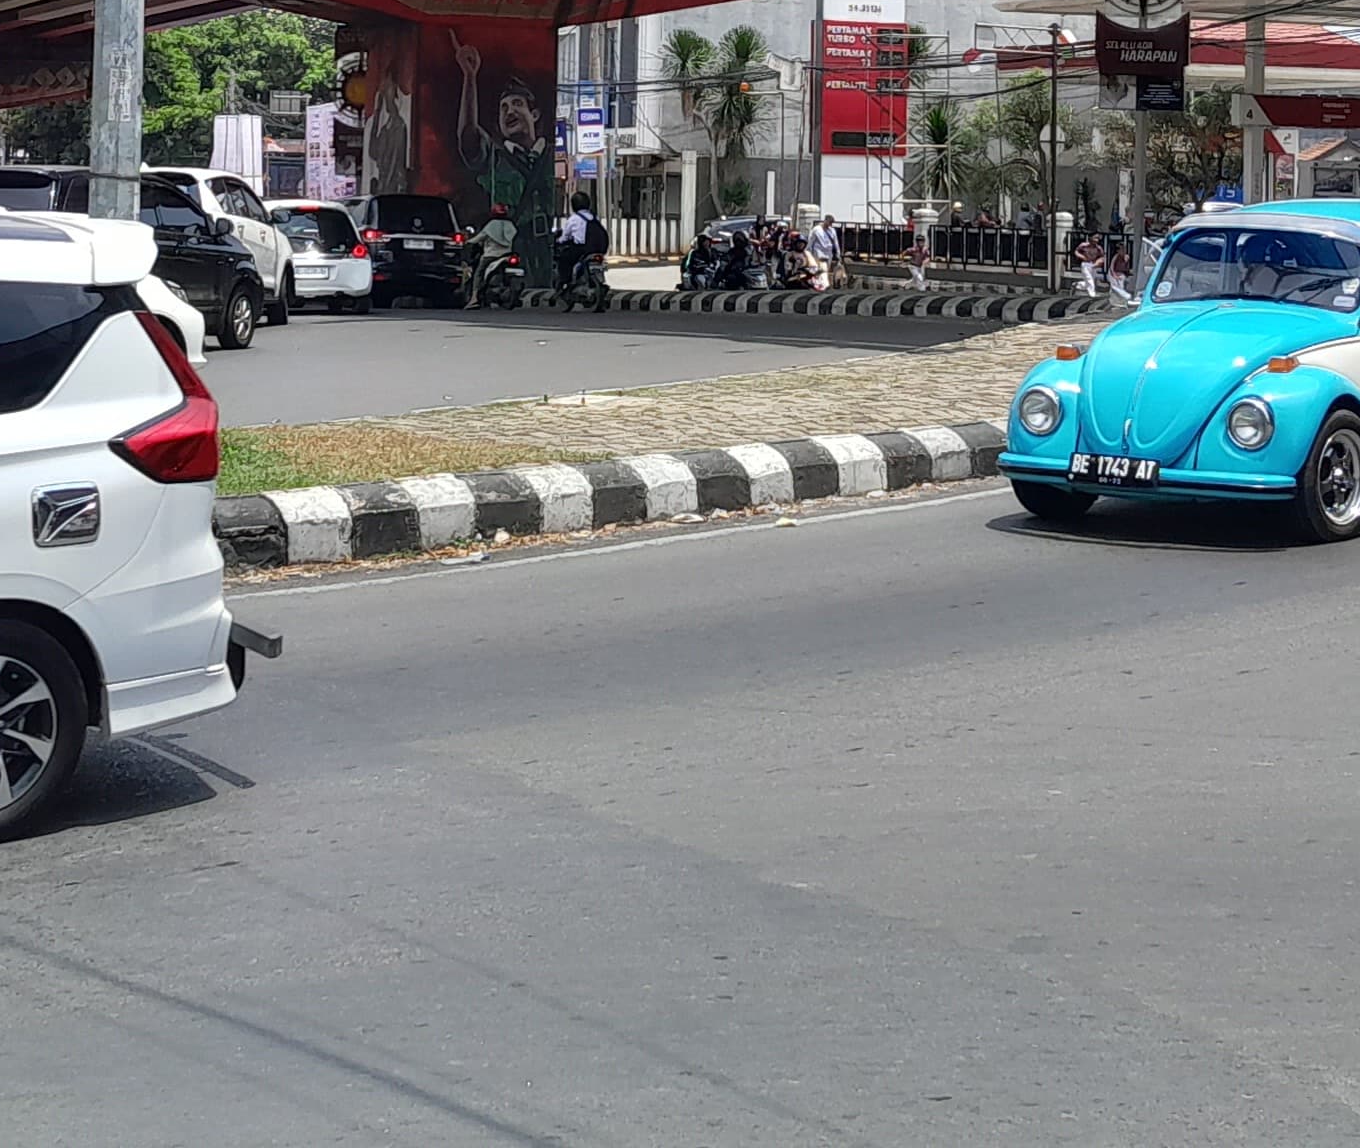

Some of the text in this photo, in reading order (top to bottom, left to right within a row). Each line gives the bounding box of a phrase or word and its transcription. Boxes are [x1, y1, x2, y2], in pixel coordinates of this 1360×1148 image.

[1120, 49, 1178, 63] HARAPAN
[1246, 108, 1255, 121] 4
[1071, 454, 1157, 480] BE 1743 AT
